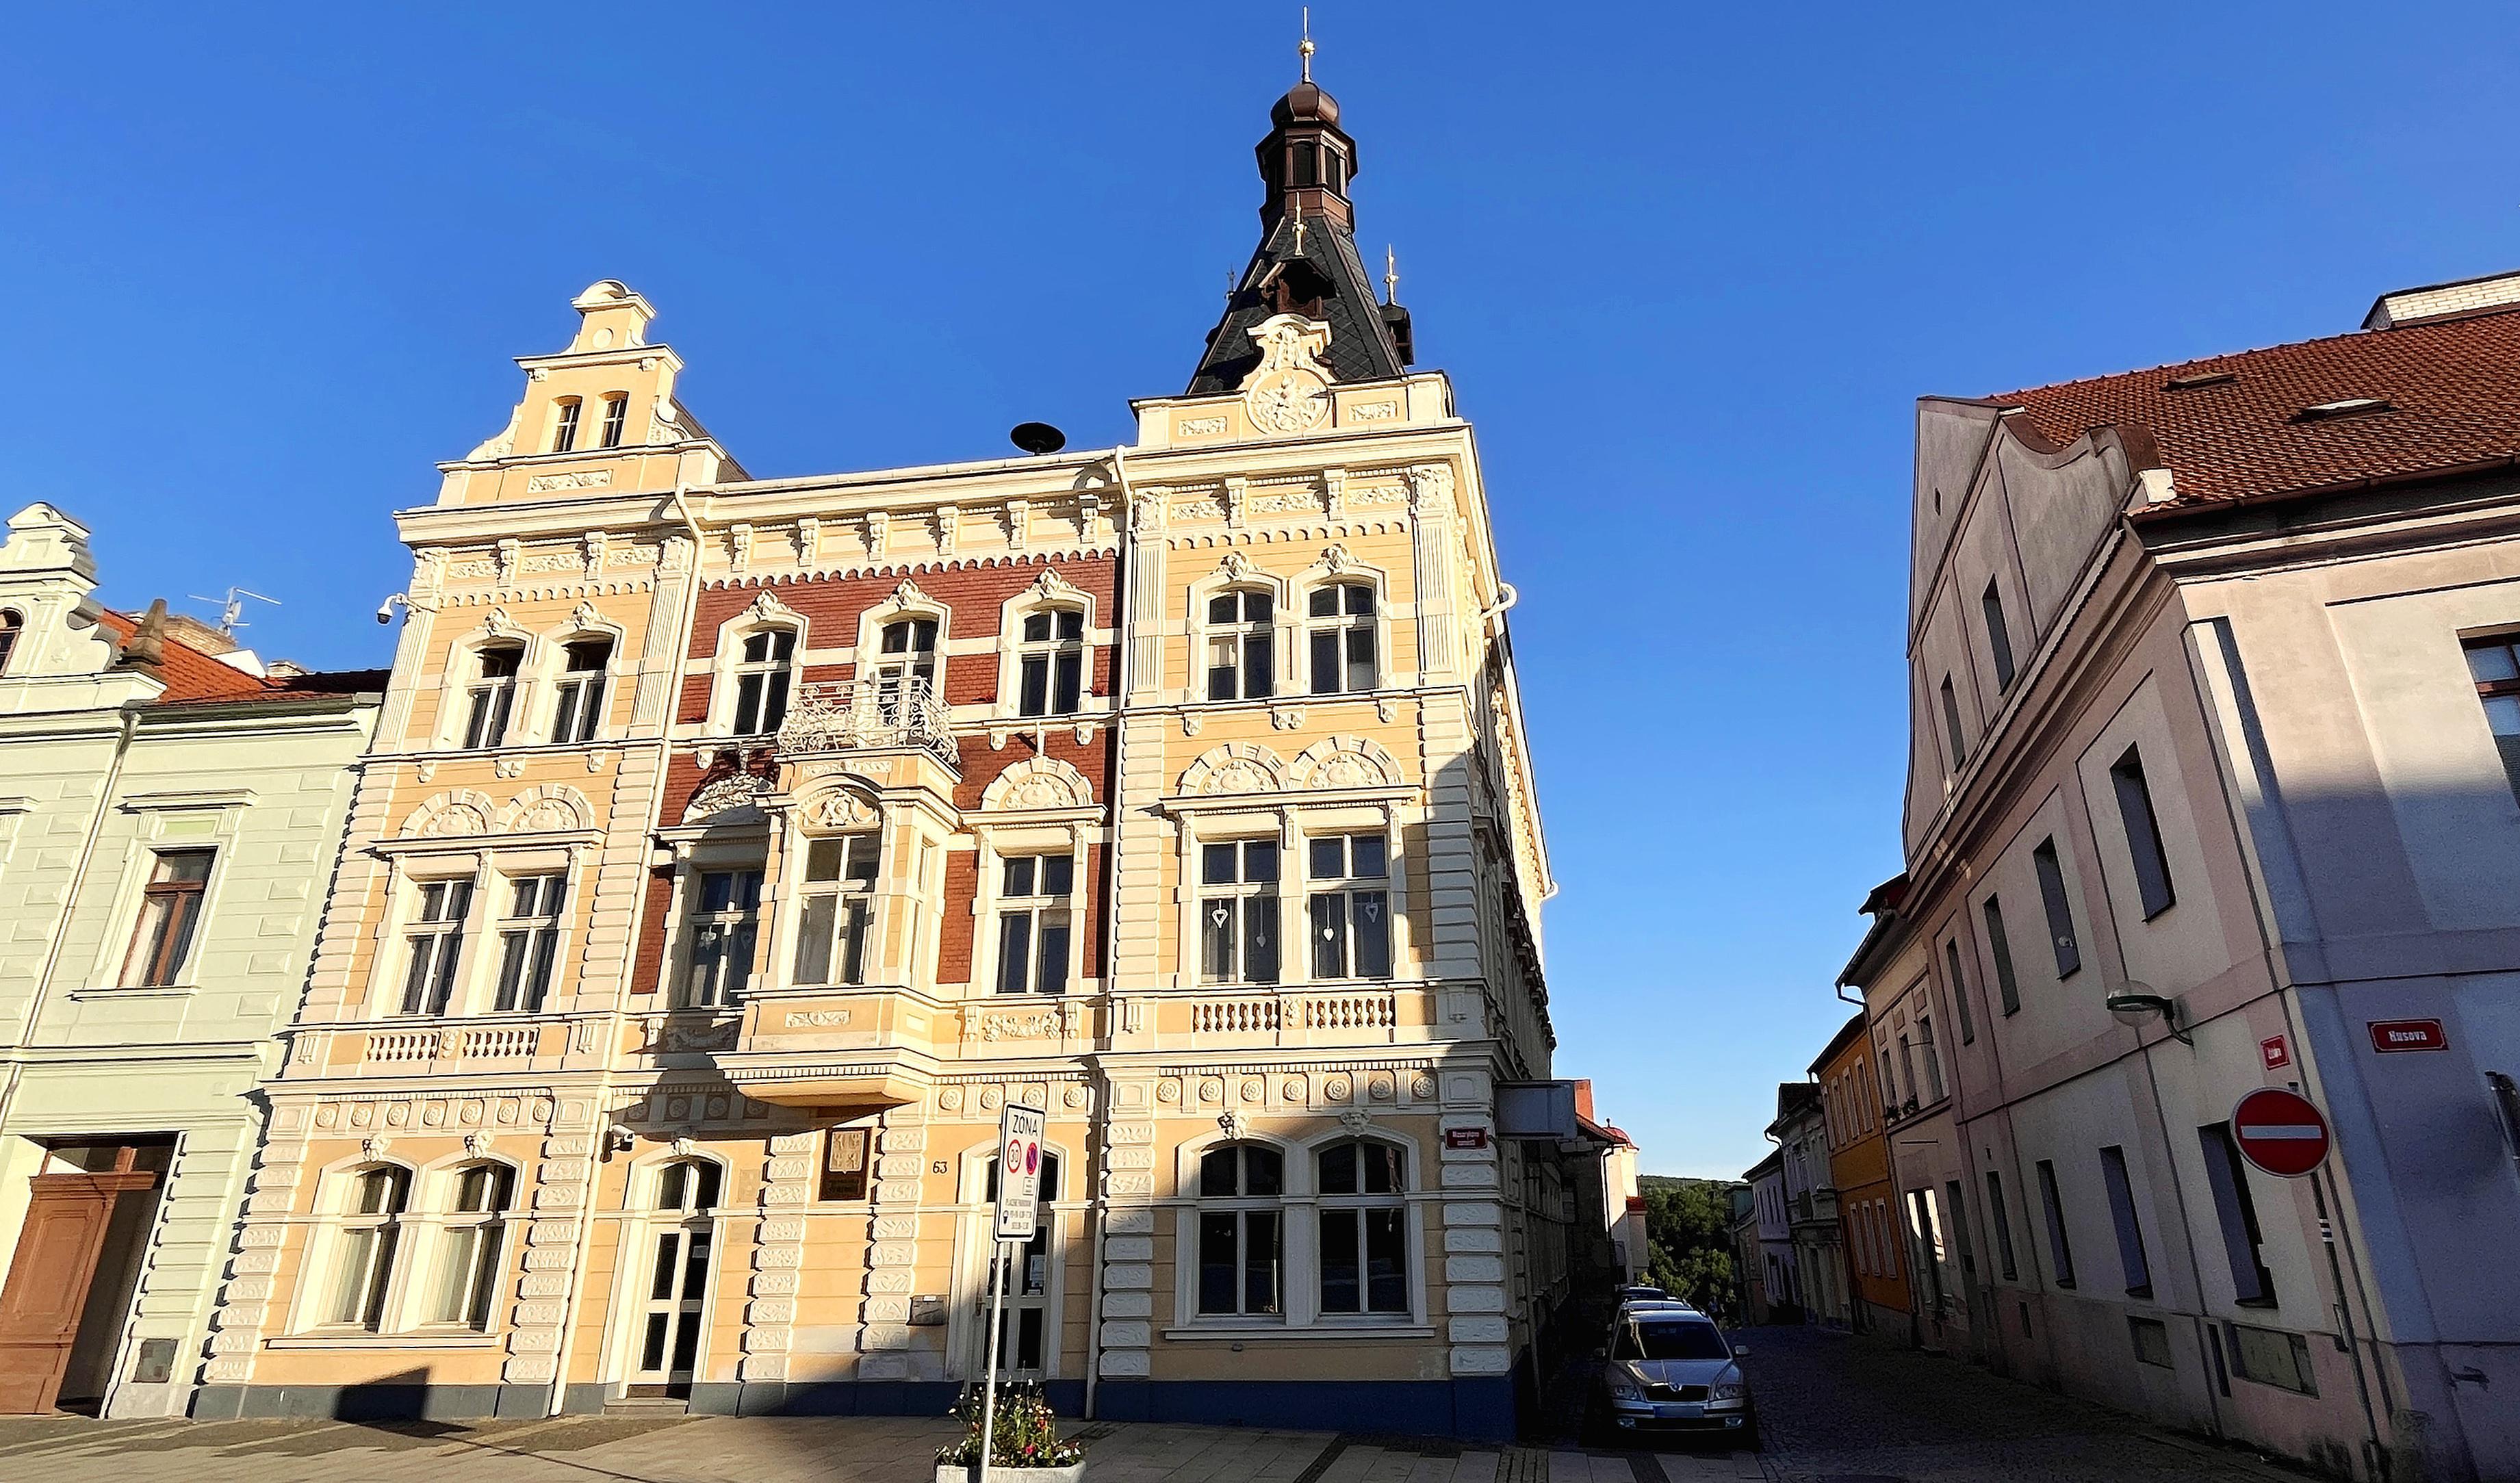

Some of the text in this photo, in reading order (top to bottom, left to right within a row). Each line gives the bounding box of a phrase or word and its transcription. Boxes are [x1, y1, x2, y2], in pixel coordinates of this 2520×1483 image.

[2388, 1031, 2427, 1042] Husova
[1012, 1111, 1038, 1137] ZÓNA
[1010, 1149, 1019, 1163] 30
[933, 1161, 947, 1174] 63
